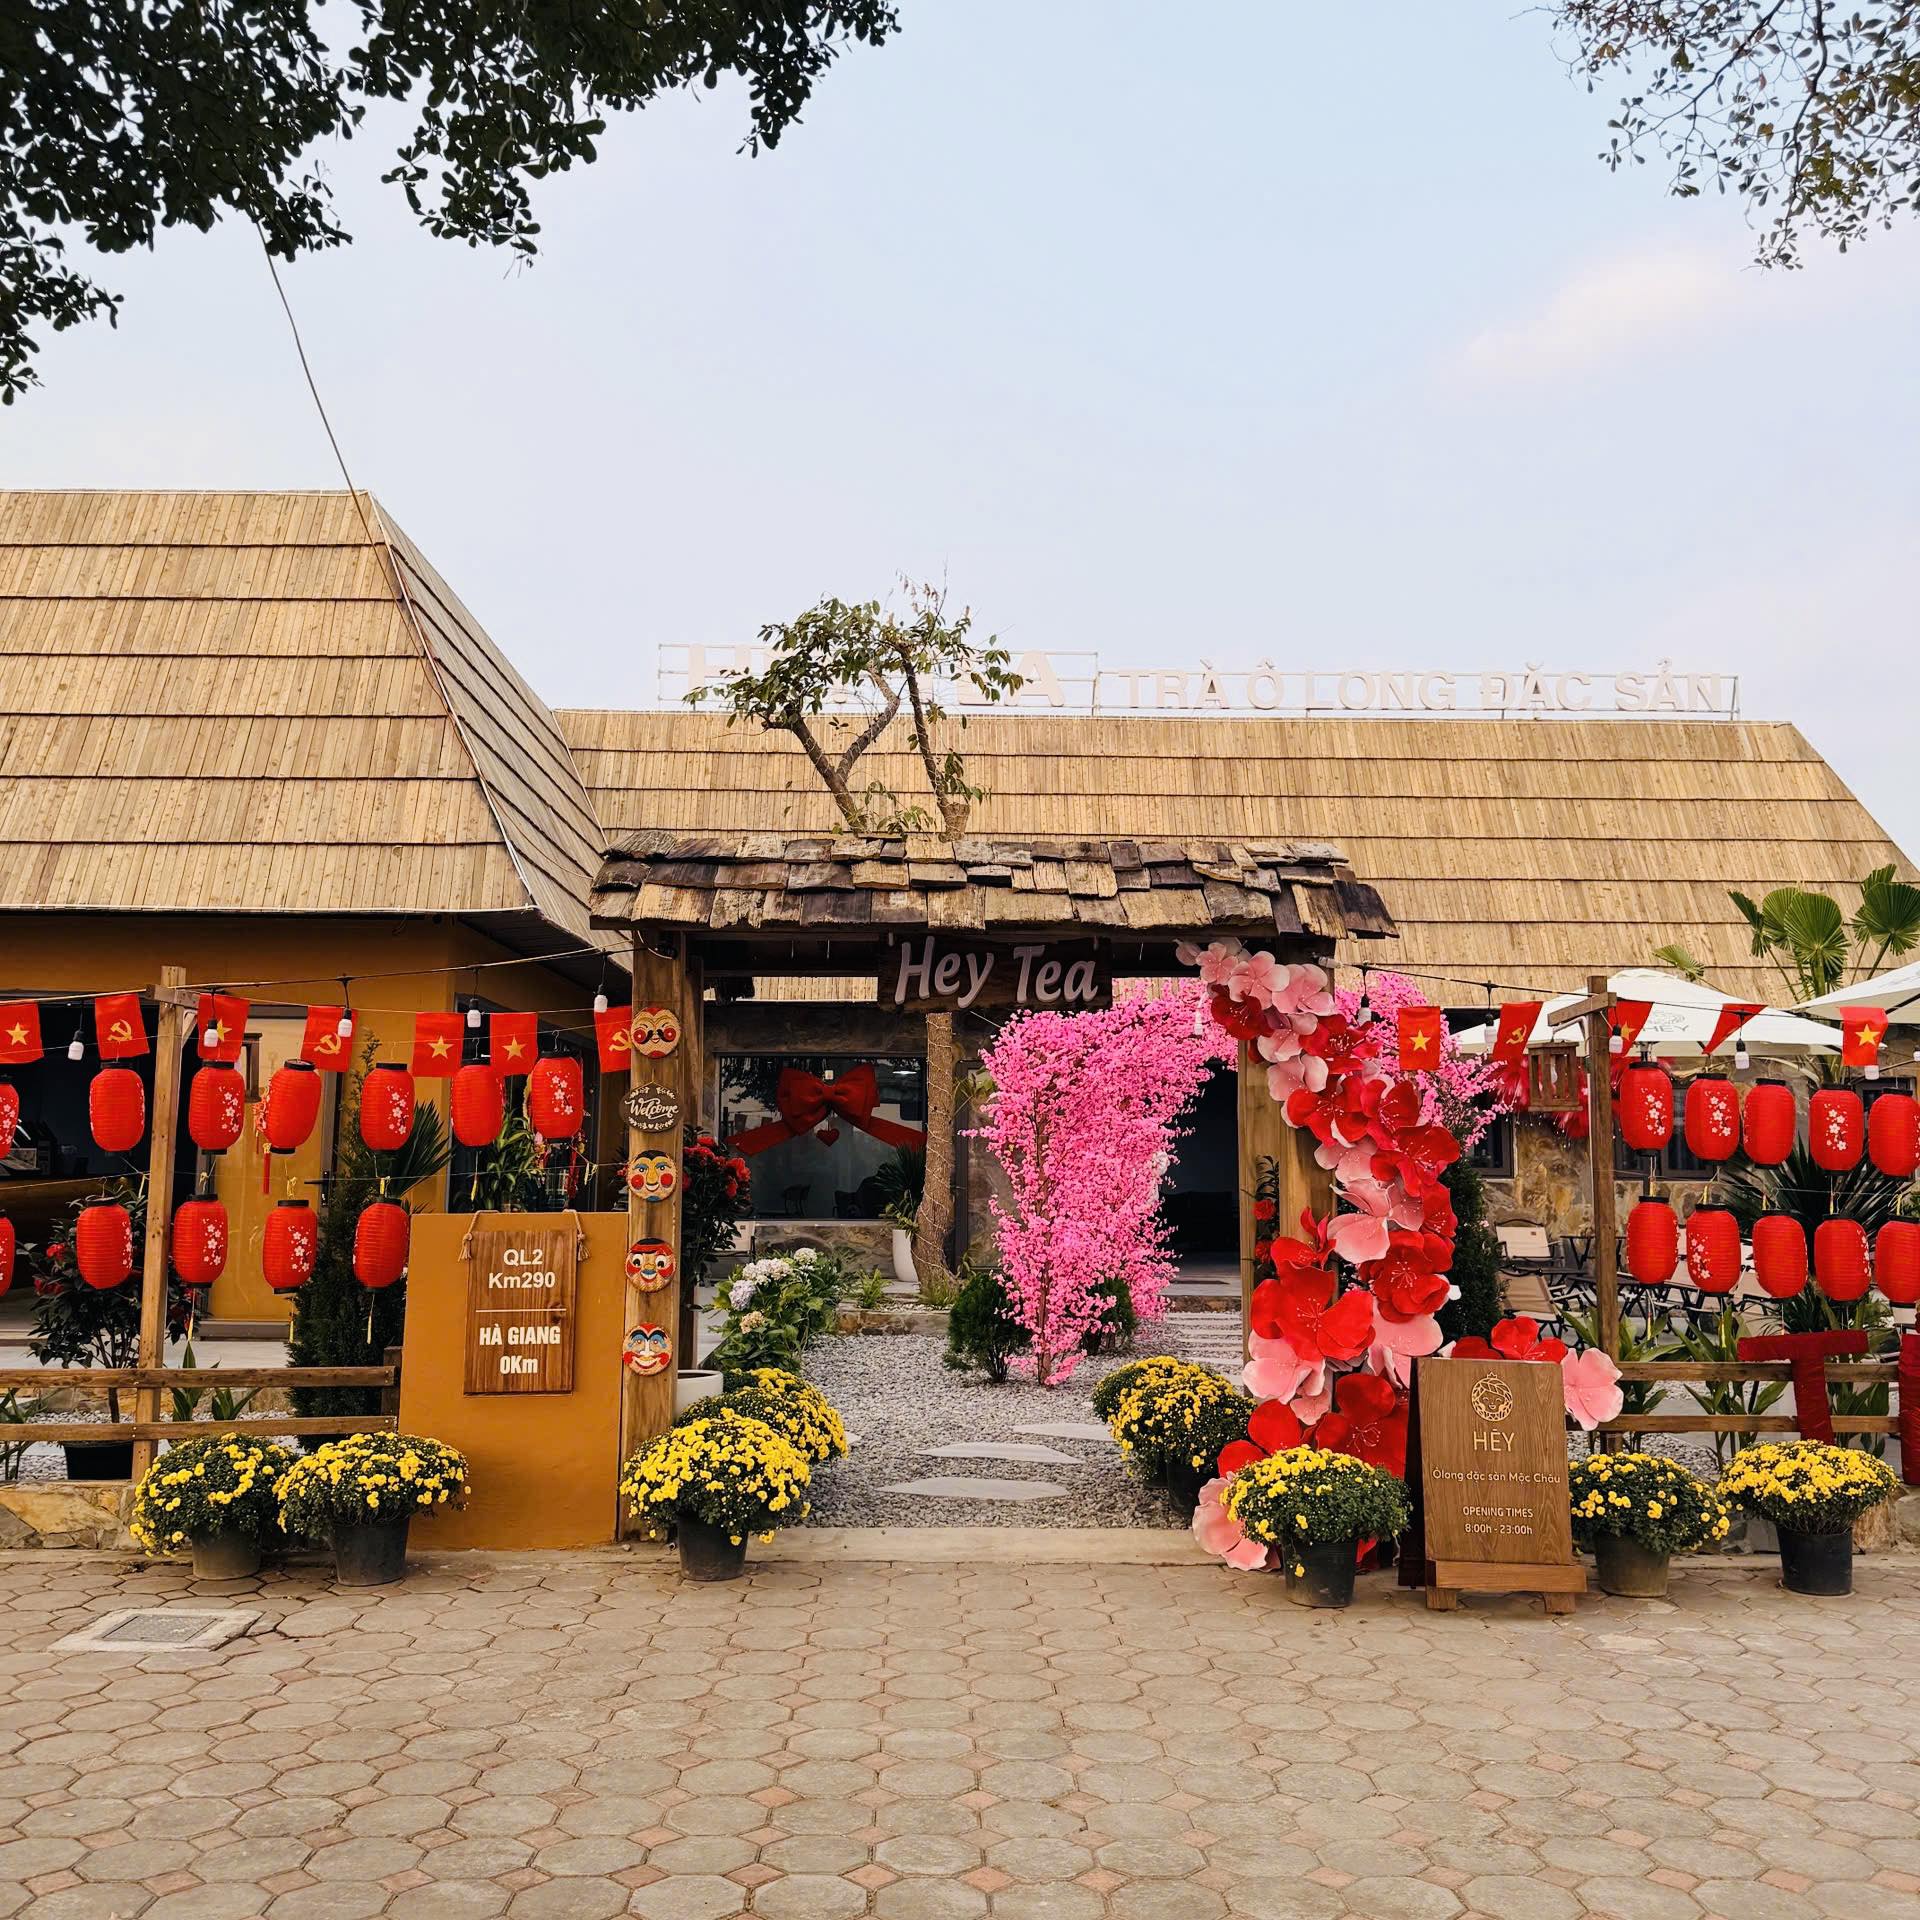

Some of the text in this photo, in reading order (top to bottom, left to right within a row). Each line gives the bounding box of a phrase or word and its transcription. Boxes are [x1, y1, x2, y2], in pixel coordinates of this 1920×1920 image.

[1117, 657, 1230, 710] TRÀ
[1304, 671, 1456, 711] LONG
[1615, 656, 1721, 713] SẢN
[894, 935, 1099, 1009] Hey Tea
[624, 1097, 679, 1119] Welcome
[503, 1248, 544, 1266] QL2
[488, 1271, 556, 1289] Km290
[479, 1323, 561, 1346] HÀ GIANG
[500, 1355, 538, 1375] 0Km
[1462, 1506, 1534, 1518] OPENING TIMES
[1465, 1523, 1492, 1533] 8:00h
[1500, 1524, 1533, 1535] 23:00h
